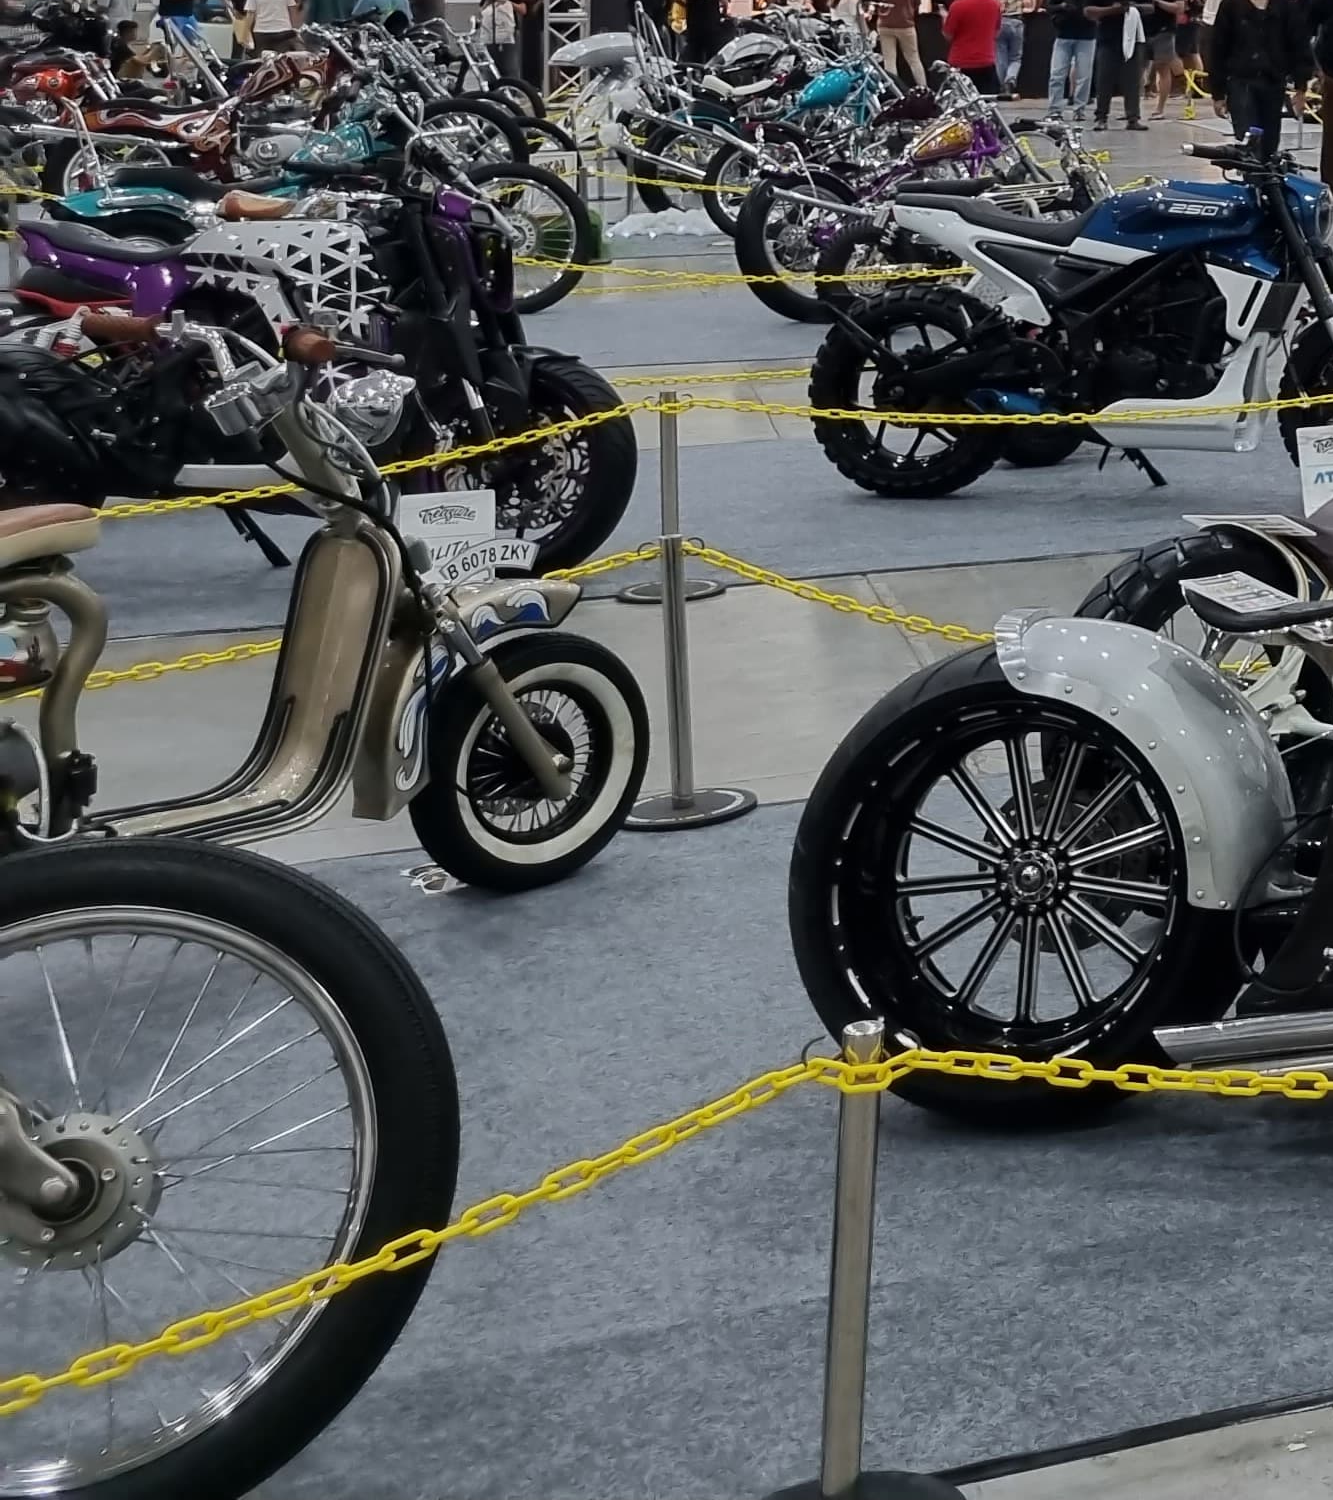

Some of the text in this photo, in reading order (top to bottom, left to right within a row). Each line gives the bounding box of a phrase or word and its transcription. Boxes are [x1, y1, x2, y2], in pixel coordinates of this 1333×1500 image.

[1168, 202, 1219, 216] 250
[431, 540, 471, 563] LITA
[447, 544, 530, 580] B 6078 ZKY
